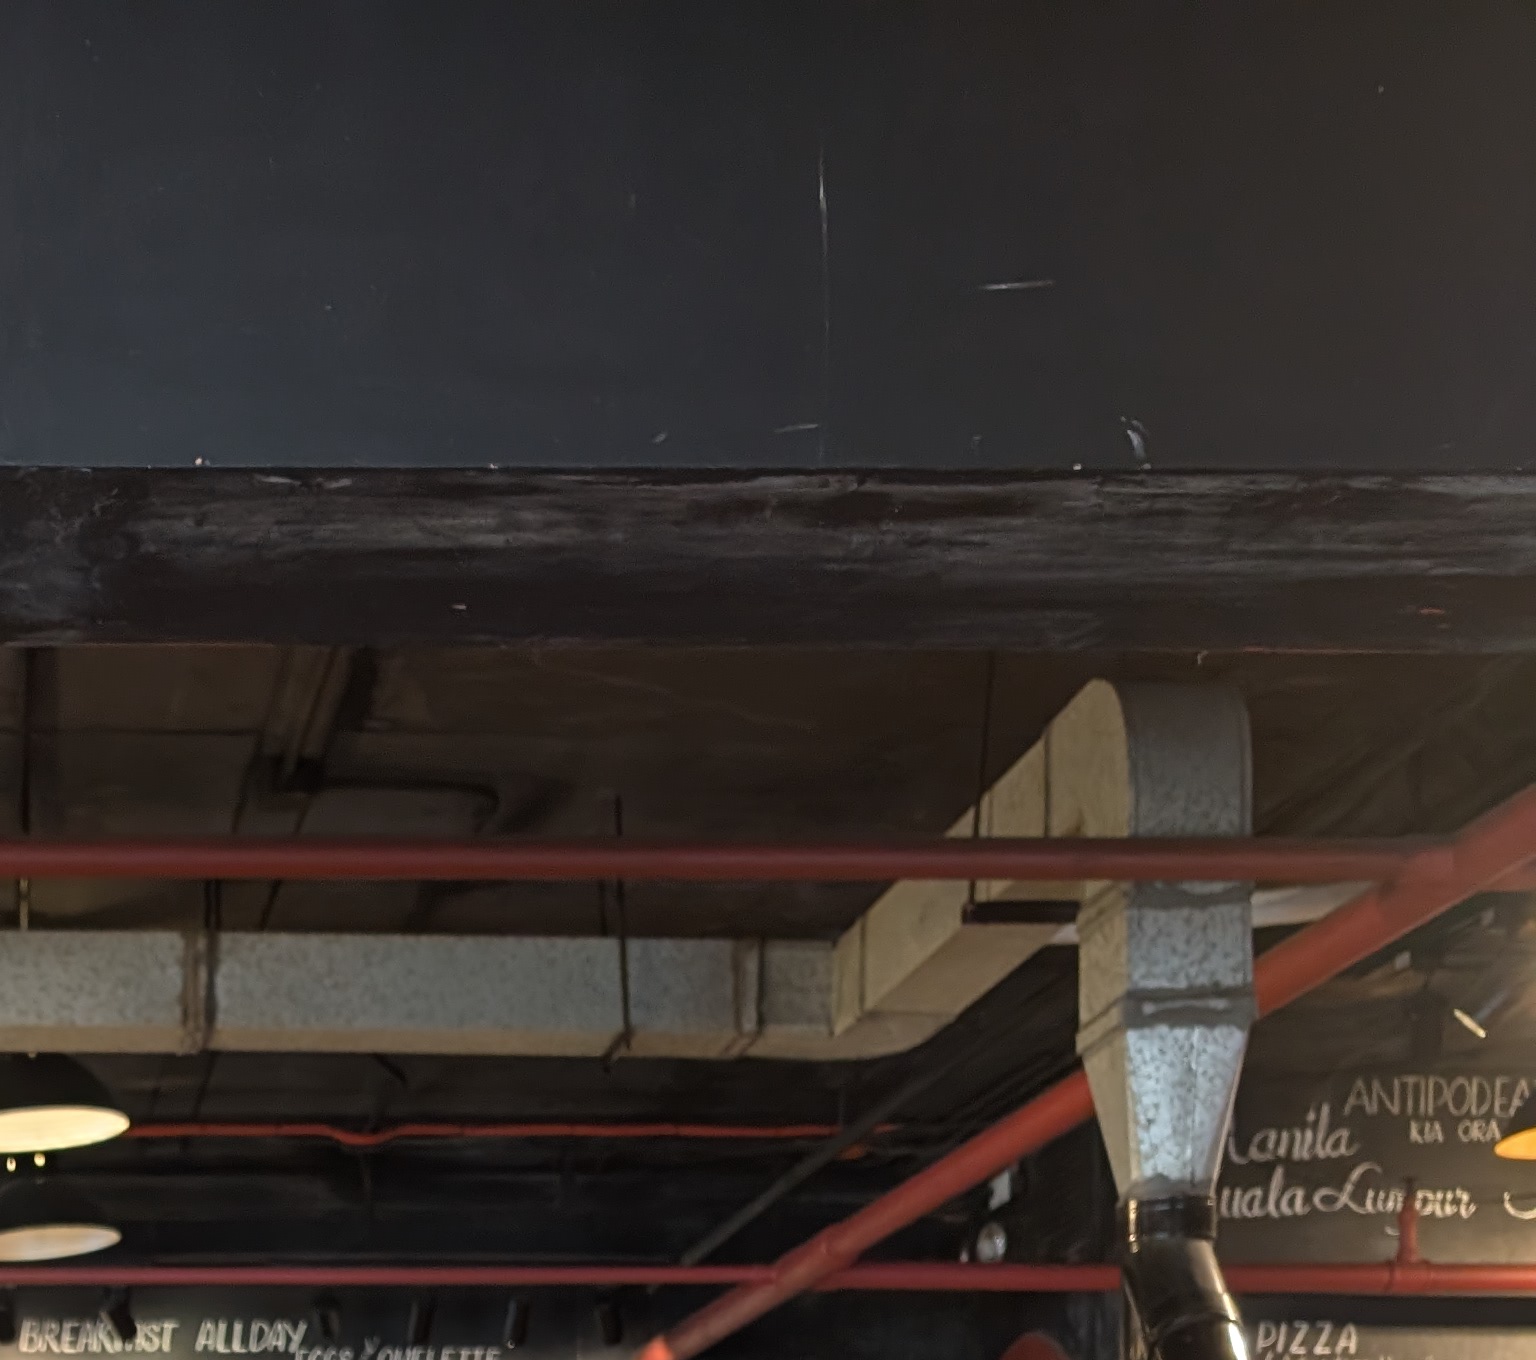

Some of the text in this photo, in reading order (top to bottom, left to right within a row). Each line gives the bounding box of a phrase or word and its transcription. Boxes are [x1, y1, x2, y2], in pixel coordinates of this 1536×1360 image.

[1344, 1075, 1536, 1118] ANTIPODEA
[1410, 1118, 1502, 1144] KIA ORA
[1220, 1164, 1312, 1219] uala
[1256, 1321, 1360, 1355] PIZZA
